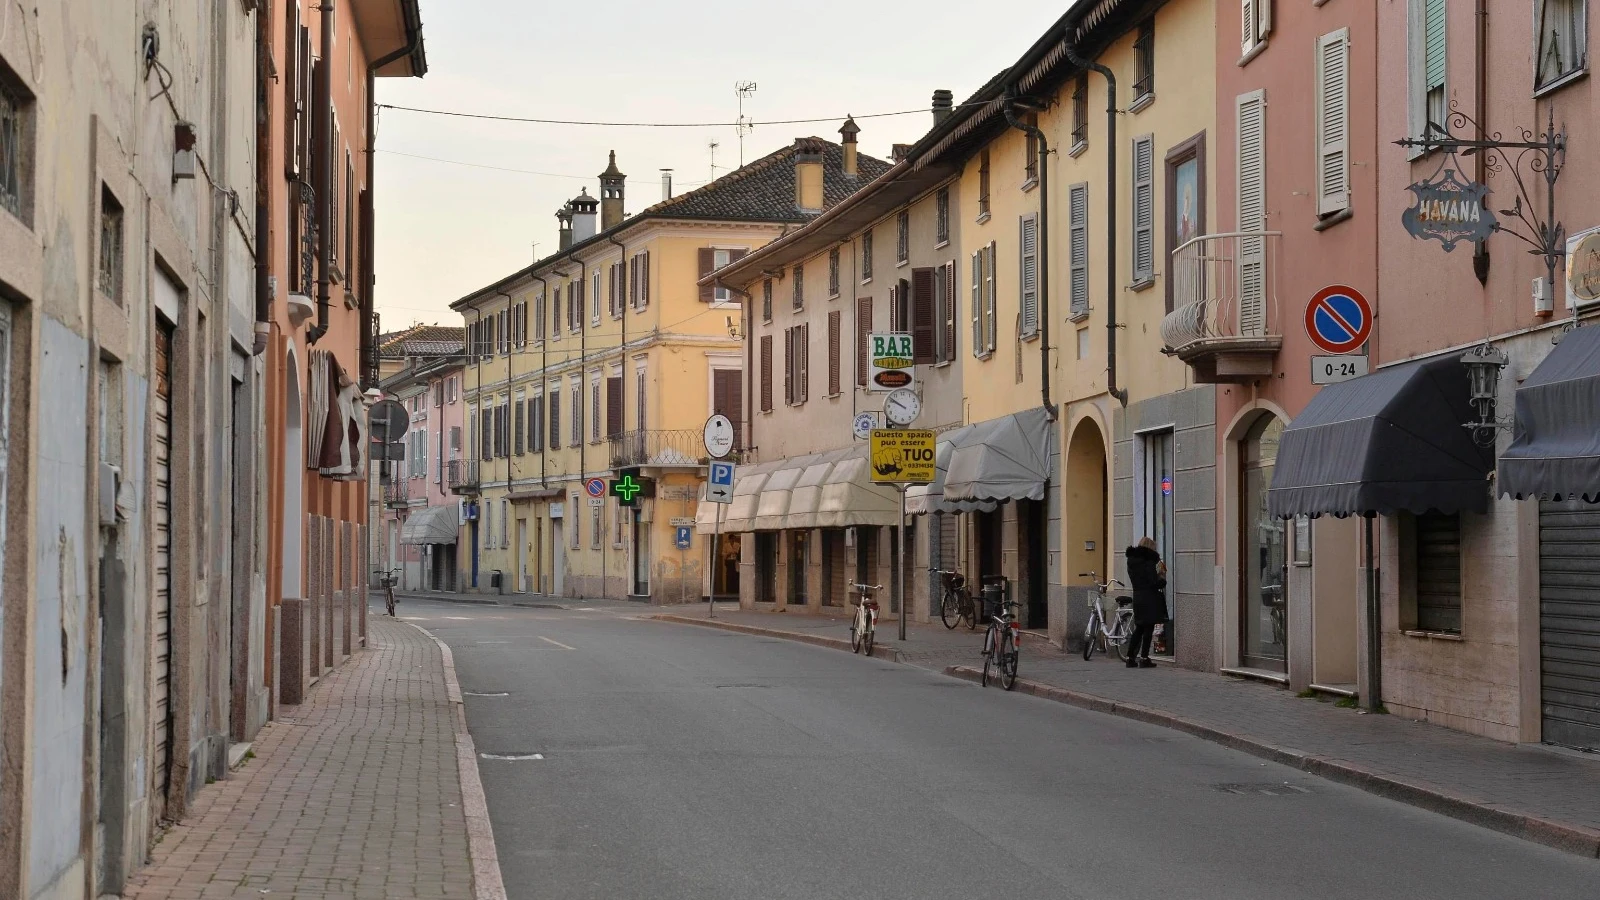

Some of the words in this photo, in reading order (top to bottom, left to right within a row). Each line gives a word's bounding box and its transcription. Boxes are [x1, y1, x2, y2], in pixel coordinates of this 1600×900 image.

[1420, 199, 1480, 222] HAVANA
[873, 336, 913, 356] BAR
[873, 357, 913, 369] CENTRALE
[1325, 363, 1356, 376] 0-24
[903, 448, 934, 461] TUO
[715, 465, 729, 483] P
[681, 529, 687, 538] P
